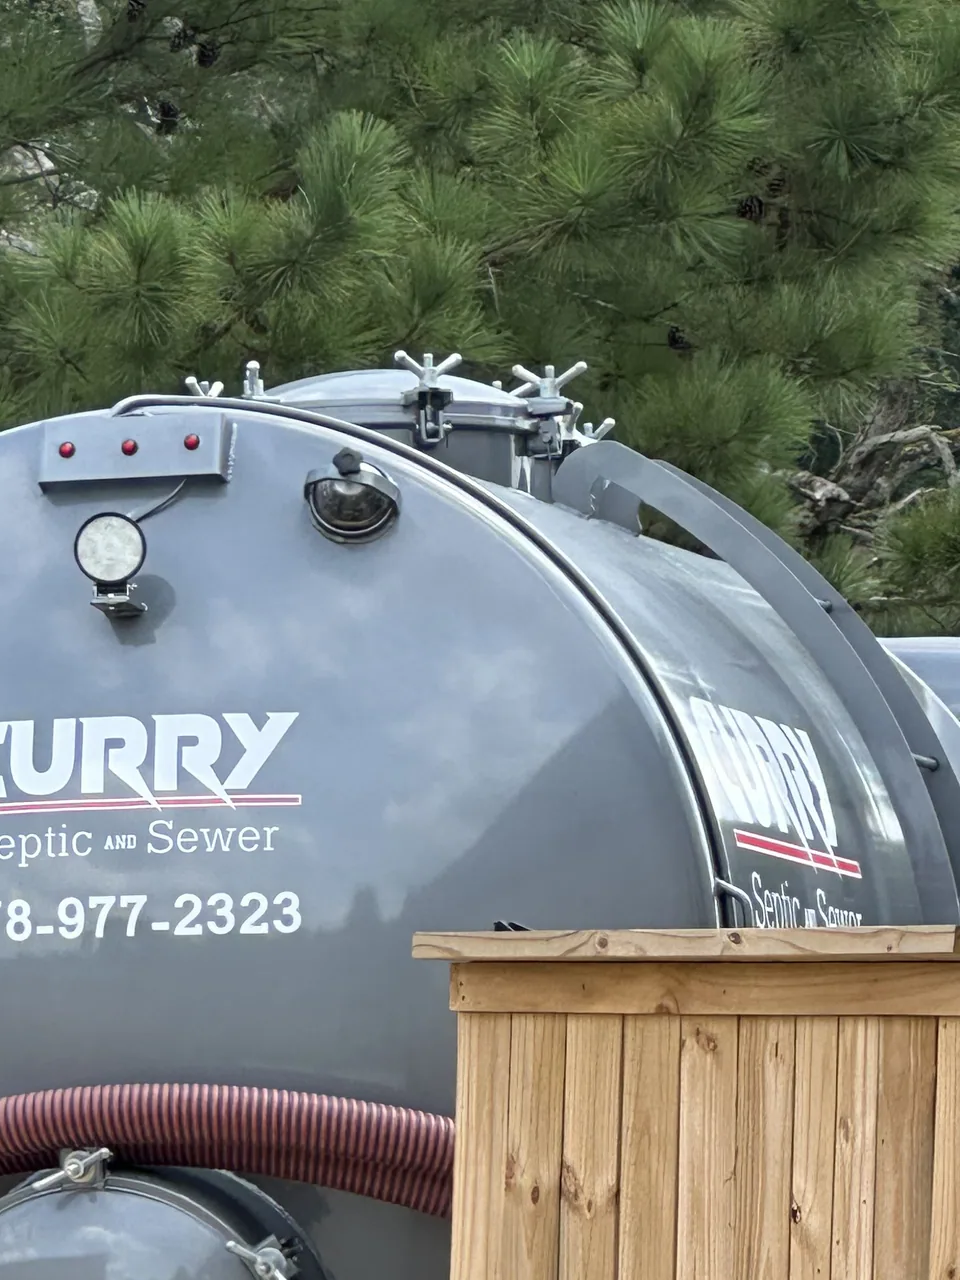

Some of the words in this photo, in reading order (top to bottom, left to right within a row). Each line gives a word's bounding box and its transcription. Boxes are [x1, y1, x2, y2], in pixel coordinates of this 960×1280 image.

[103, 834, 137, 850] AND
[147, 820, 279, 854] Sewer
[690, 696, 841, 877] CURRY
